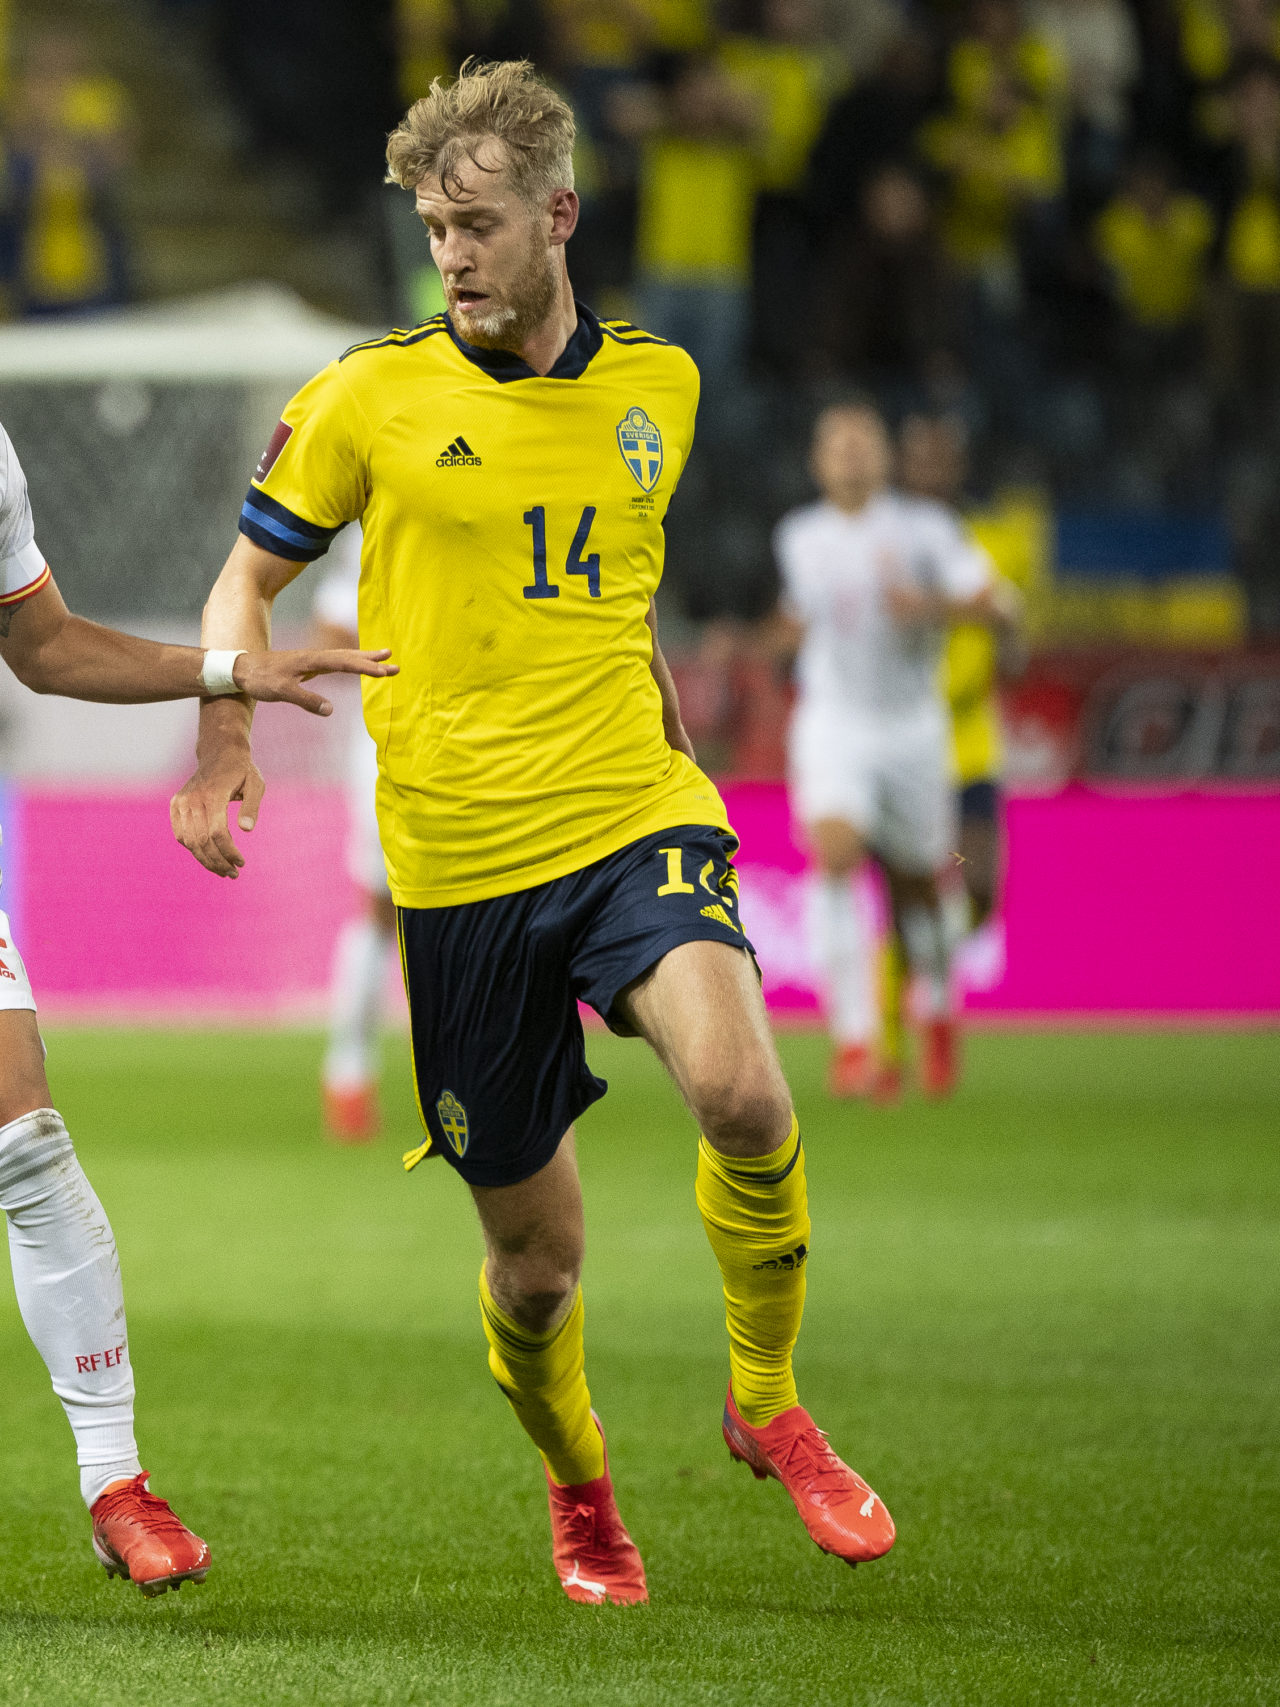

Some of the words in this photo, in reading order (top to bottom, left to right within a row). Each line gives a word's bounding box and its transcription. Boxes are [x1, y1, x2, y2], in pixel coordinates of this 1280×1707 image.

[625, 431, 654, 441] SVERIGE
[434, 455, 482, 468] adidas
[523, 506, 601, 599] 14
[752, 1251, 809, 1271] adida
[75, 1345, 123, 1374] RFEF
